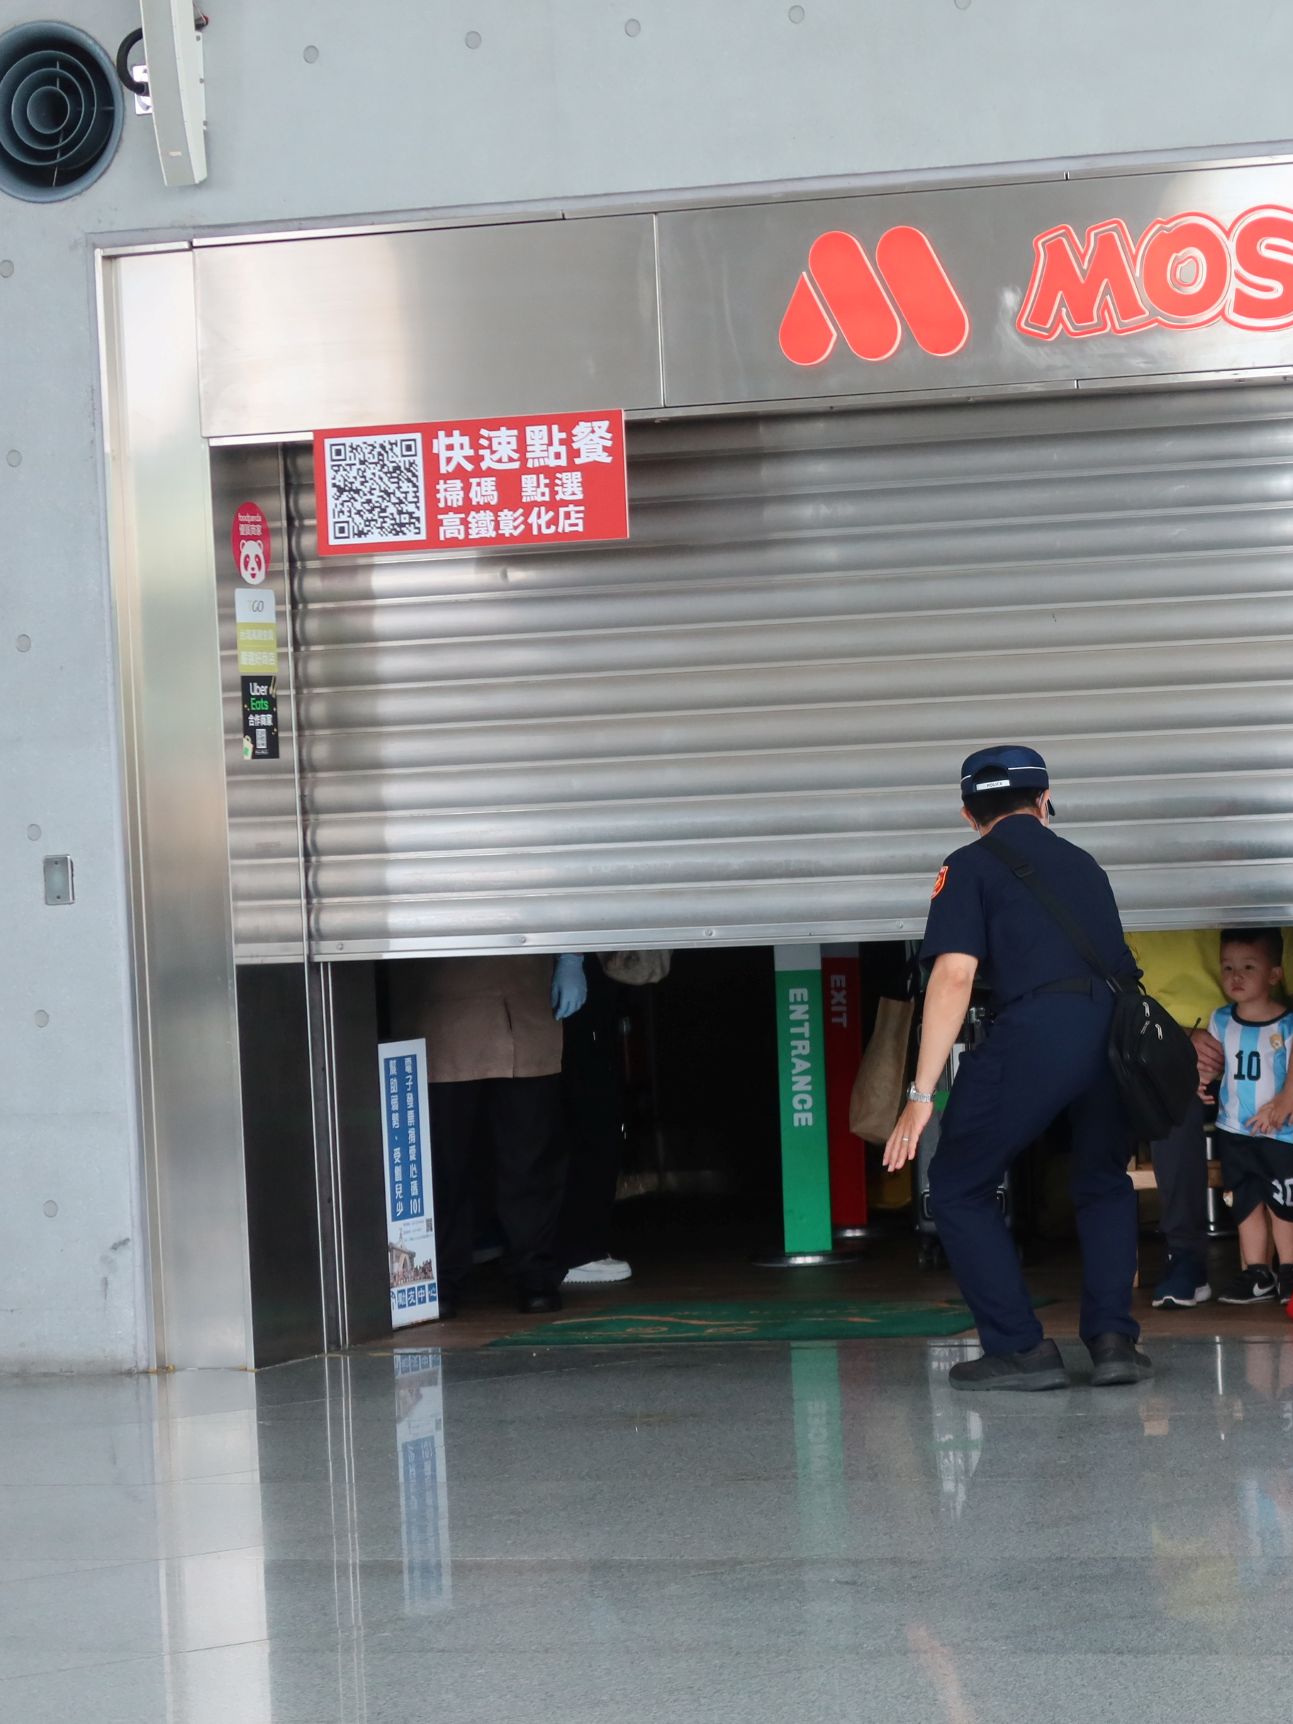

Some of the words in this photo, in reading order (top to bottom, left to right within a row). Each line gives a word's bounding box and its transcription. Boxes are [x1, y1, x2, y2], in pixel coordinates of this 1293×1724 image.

[432, 420, 613, 474] 快速點餐
[435, 477, 499, 508] 掃碼
[520, 471, 584, 503] 點選
[437, 504, 585, 541] 高鐵彰化店
[249, 682, 268, 696] Uber
[250, 697, 269, 711] Eats
[830, 974, 848, 1028] EXIT
[788, 987, 813, 1127] ENTRANCE
[1233, 1050, 1261, 1081] 10
